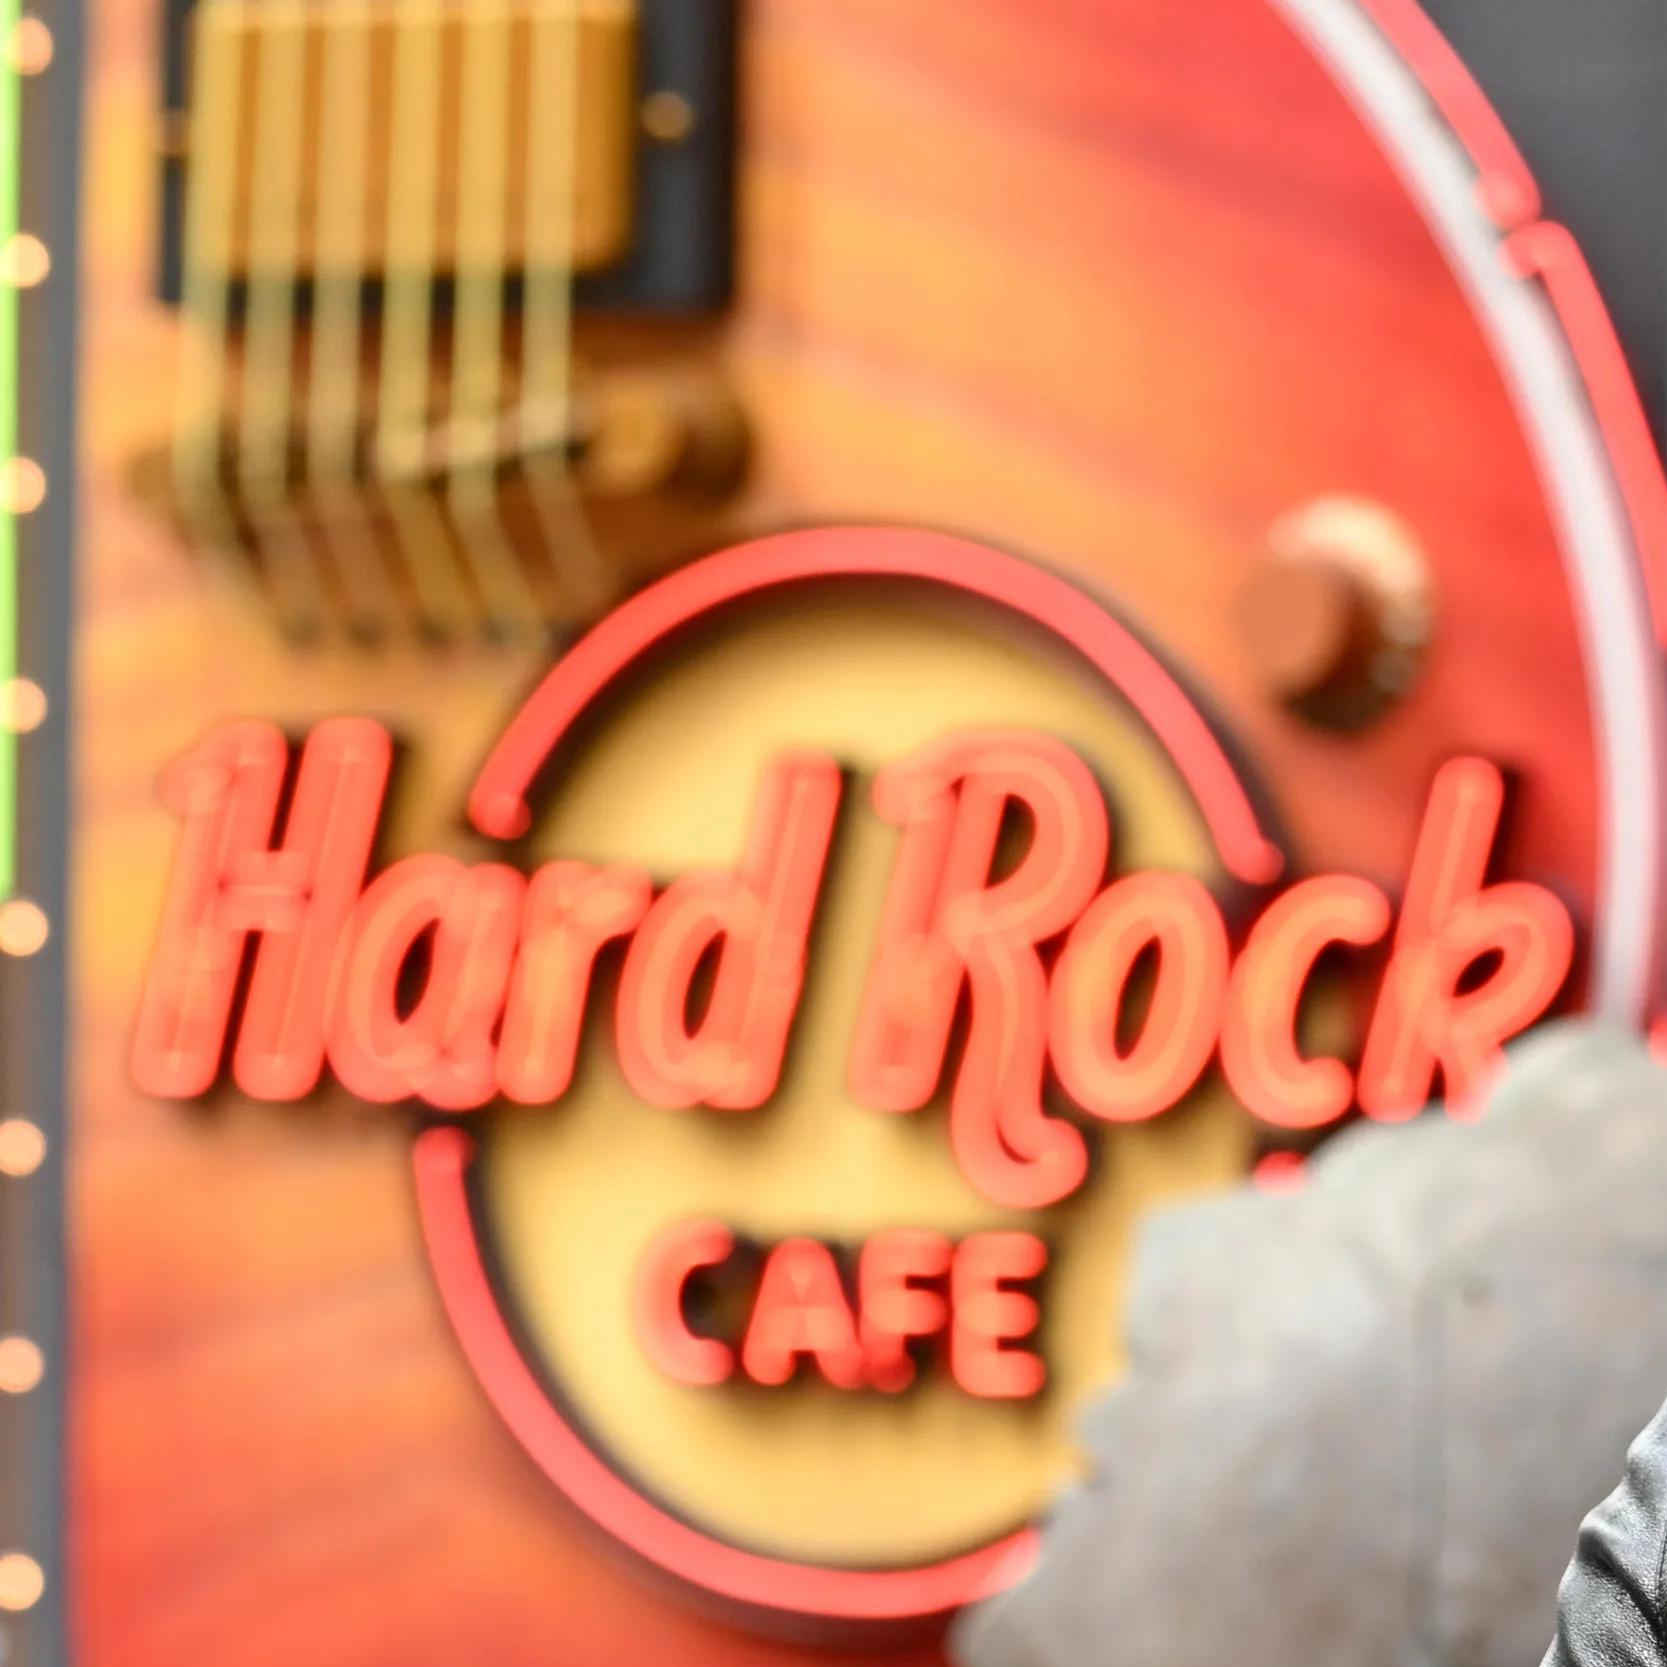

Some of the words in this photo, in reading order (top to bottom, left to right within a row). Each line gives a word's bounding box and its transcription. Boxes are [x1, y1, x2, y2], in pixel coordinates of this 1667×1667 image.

[129, 718, 844, 1110] Hard
[846, 726, 1574, 1209] Rock
[633, 1218, 1049, 1400] CAFE
